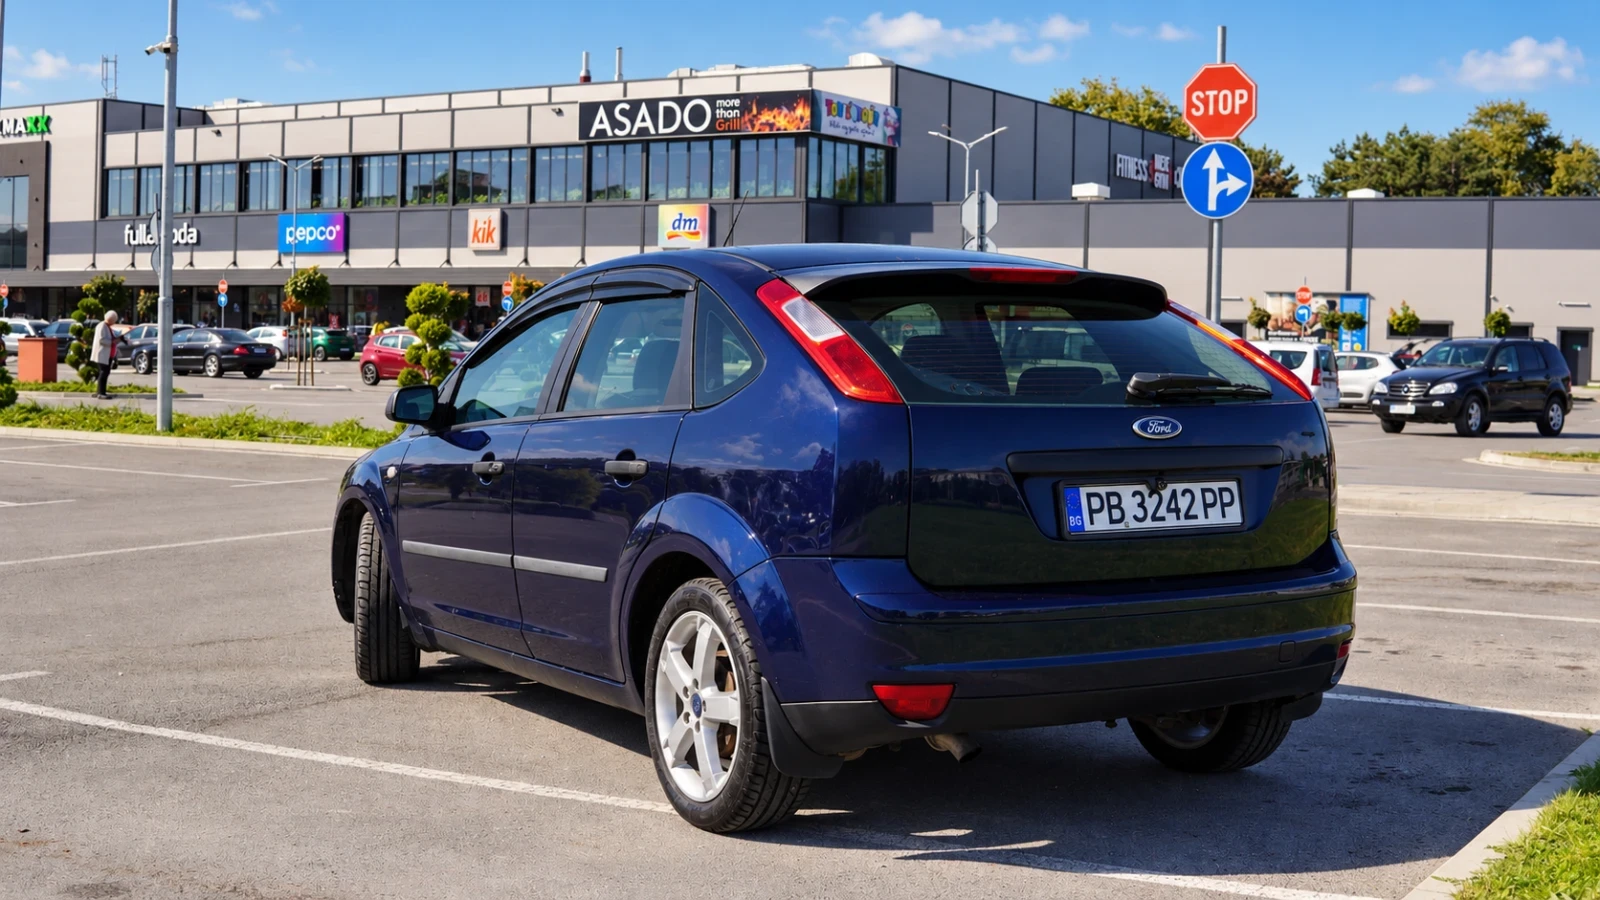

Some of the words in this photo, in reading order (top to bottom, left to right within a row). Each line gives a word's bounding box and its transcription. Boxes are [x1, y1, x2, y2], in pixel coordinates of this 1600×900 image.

[716, 98, 740, 108] more
[1191, 89, 1248, 117] STOP
[589, 98, 712, 138] ASADO
[716, 108, 740, 119] than
[0, 115, 49, 135] MAXX
[715, 118, 741, 131] Grill
[472, 217, 496, 244] kik
[671, 212, 699, 231] dm
[286, 225, 337, 245] pepco
[1147, 420, 1172, 434] Ford
[1085, 491, 1126, 526] PB
[1131, 488, 1199, 523] 3242
[1200, 487, 1235, 519] PP
[1069, 516, 1082, 527] BG
